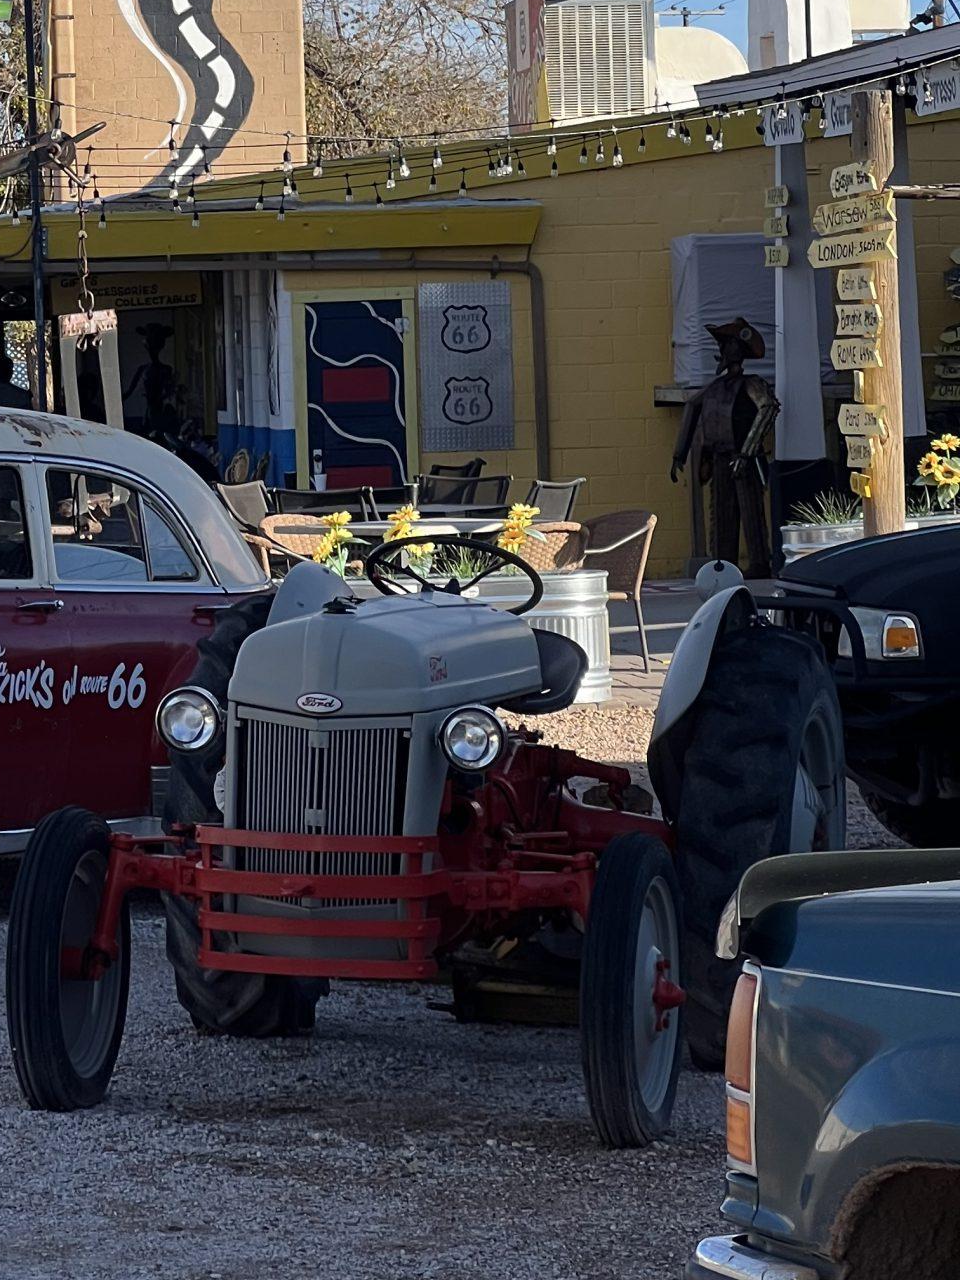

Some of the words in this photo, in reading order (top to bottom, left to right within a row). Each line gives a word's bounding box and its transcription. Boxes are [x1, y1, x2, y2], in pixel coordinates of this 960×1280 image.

[60, 275, 98, 289] GIFS
[85, 283, 158, 297] CCESSORIES
[451, 313, 481, 322] ROUTE
[452, 325, 479, 345] 66
[453, 383, 482, 394] ROUTE
[454, 397, 480, 417] 66
[80, 675, 108, 695] ROUTE
[107, 662, 147, 709] 66
[302, 696, 335, 708] Ford
